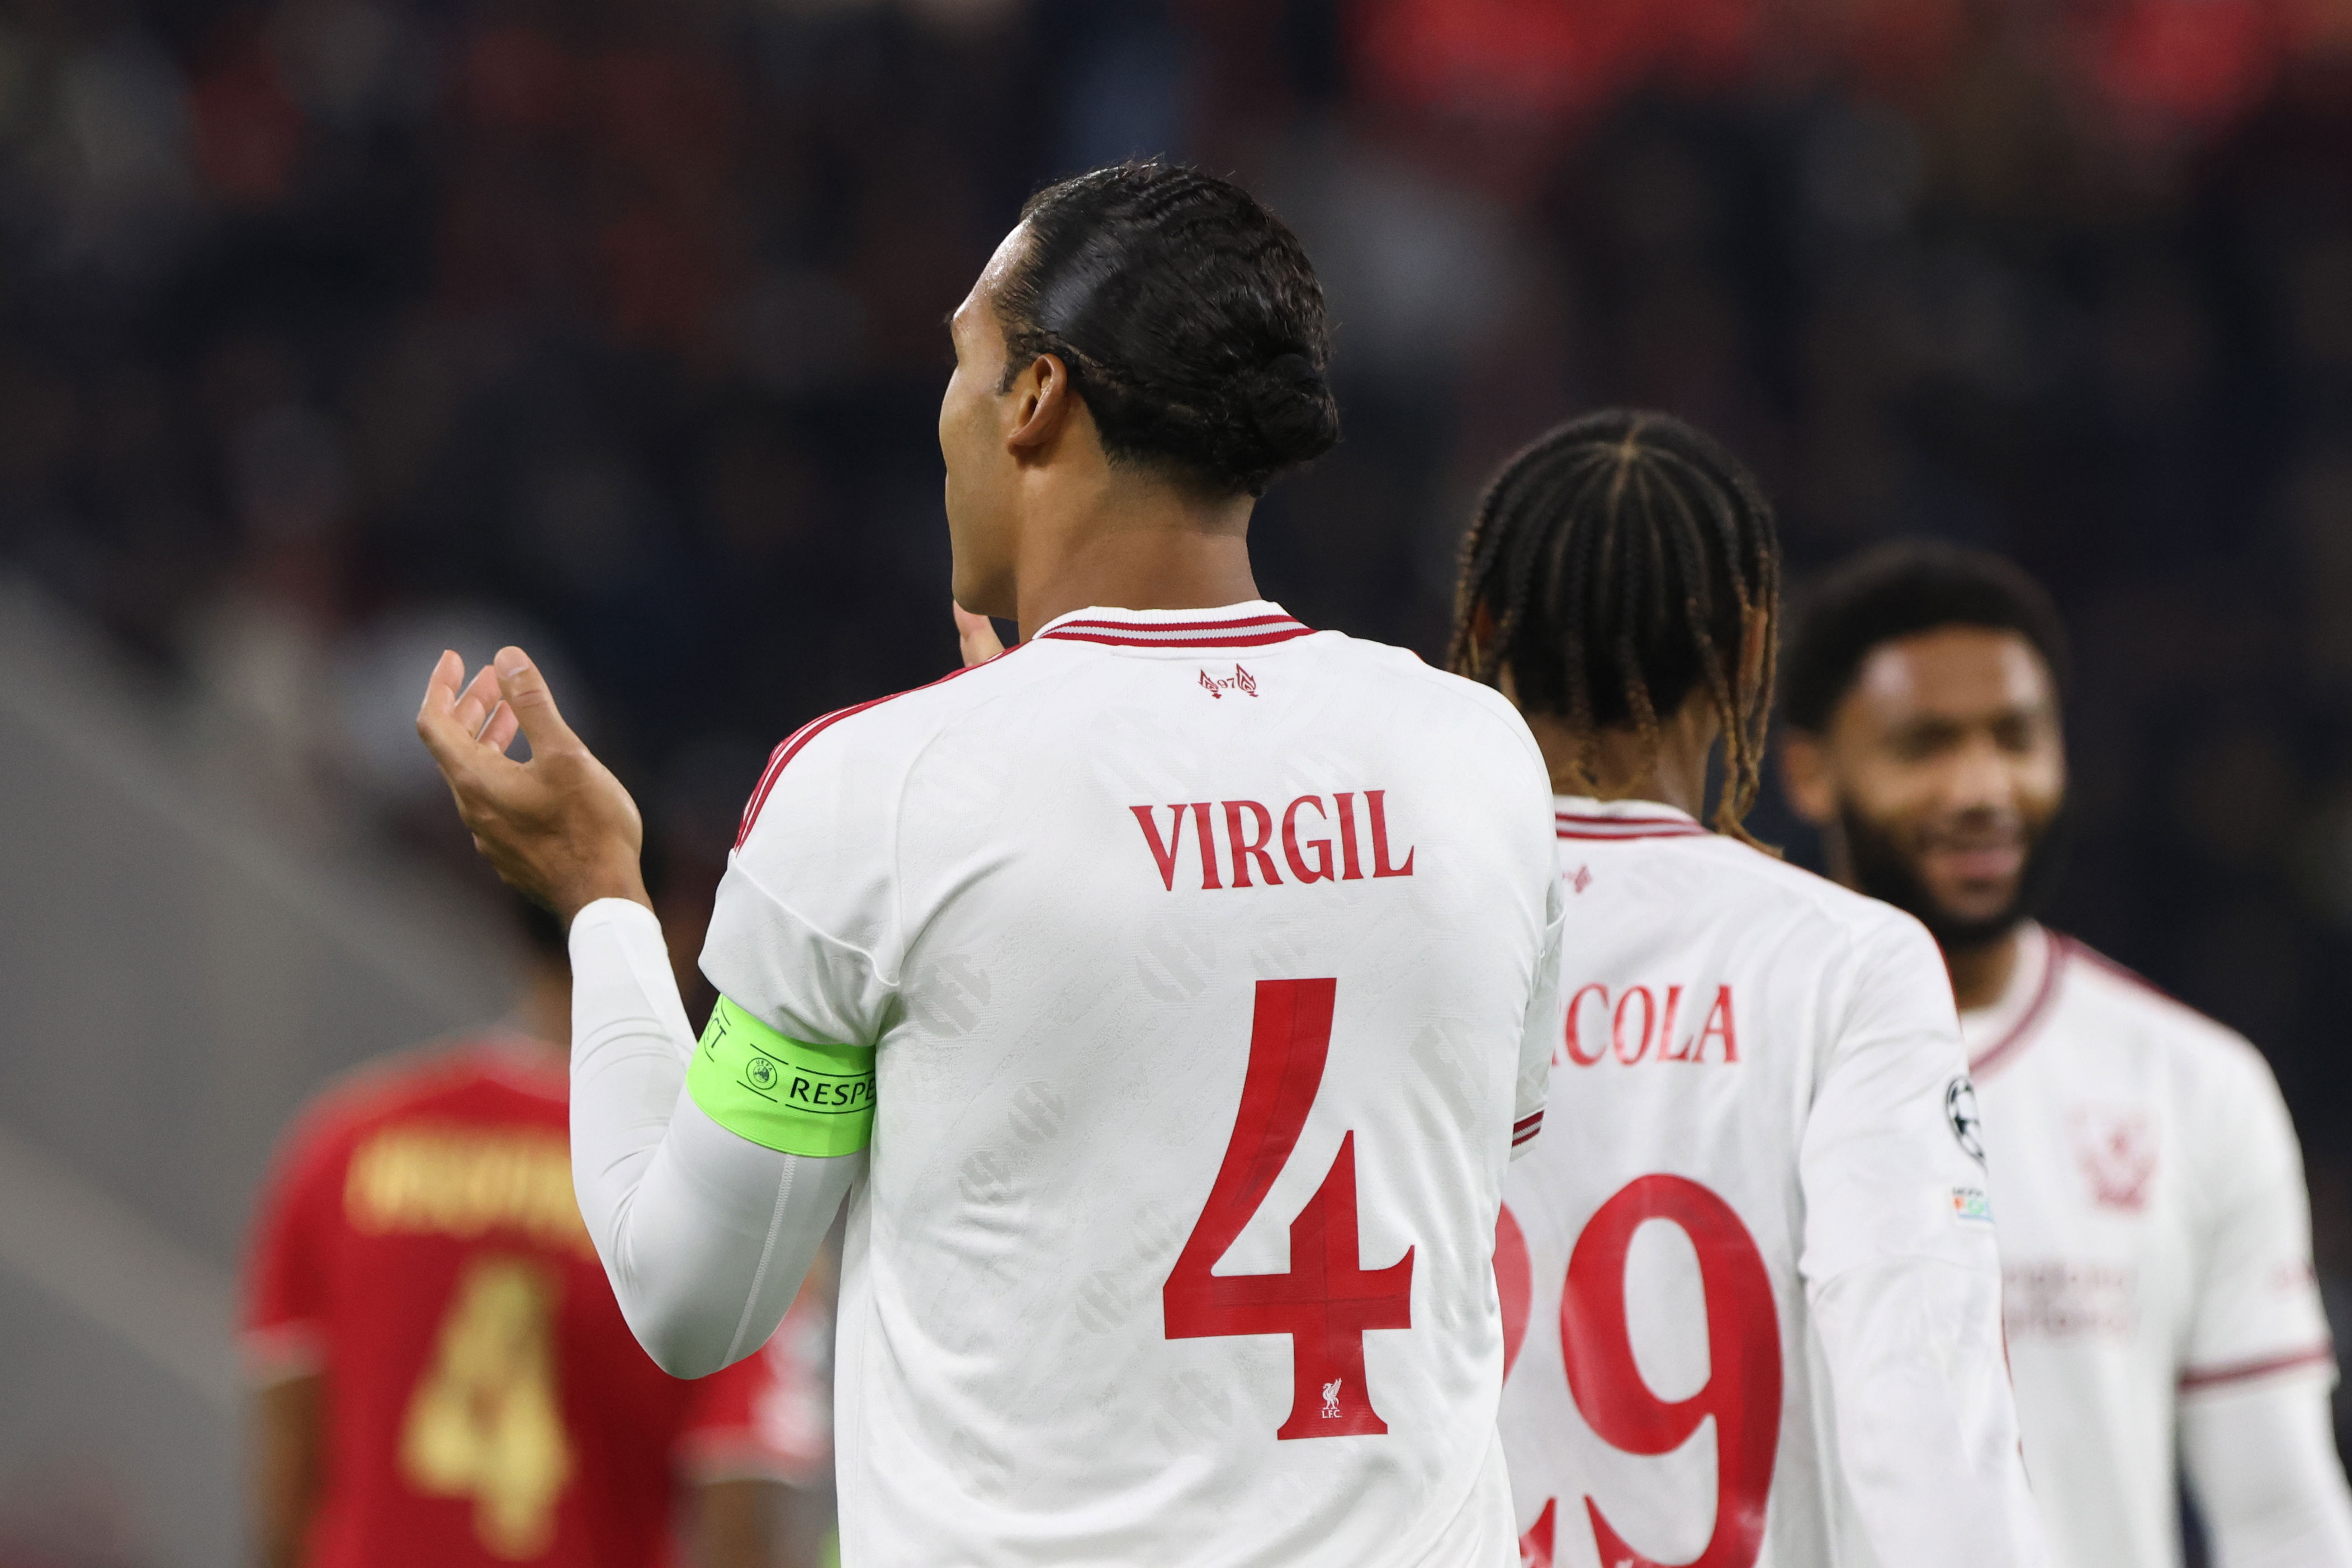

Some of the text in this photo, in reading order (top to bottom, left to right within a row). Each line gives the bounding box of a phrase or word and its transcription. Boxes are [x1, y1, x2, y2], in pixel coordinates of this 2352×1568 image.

[1217, 678, 1235, 689] 97
[1129, 789, 1414, 892] VIRGIL
[756, 1059, 773, 1072] UEFA
[1551, 983, 1740, 1069] COLA
[1163, 977, 1416, 1441] 4
